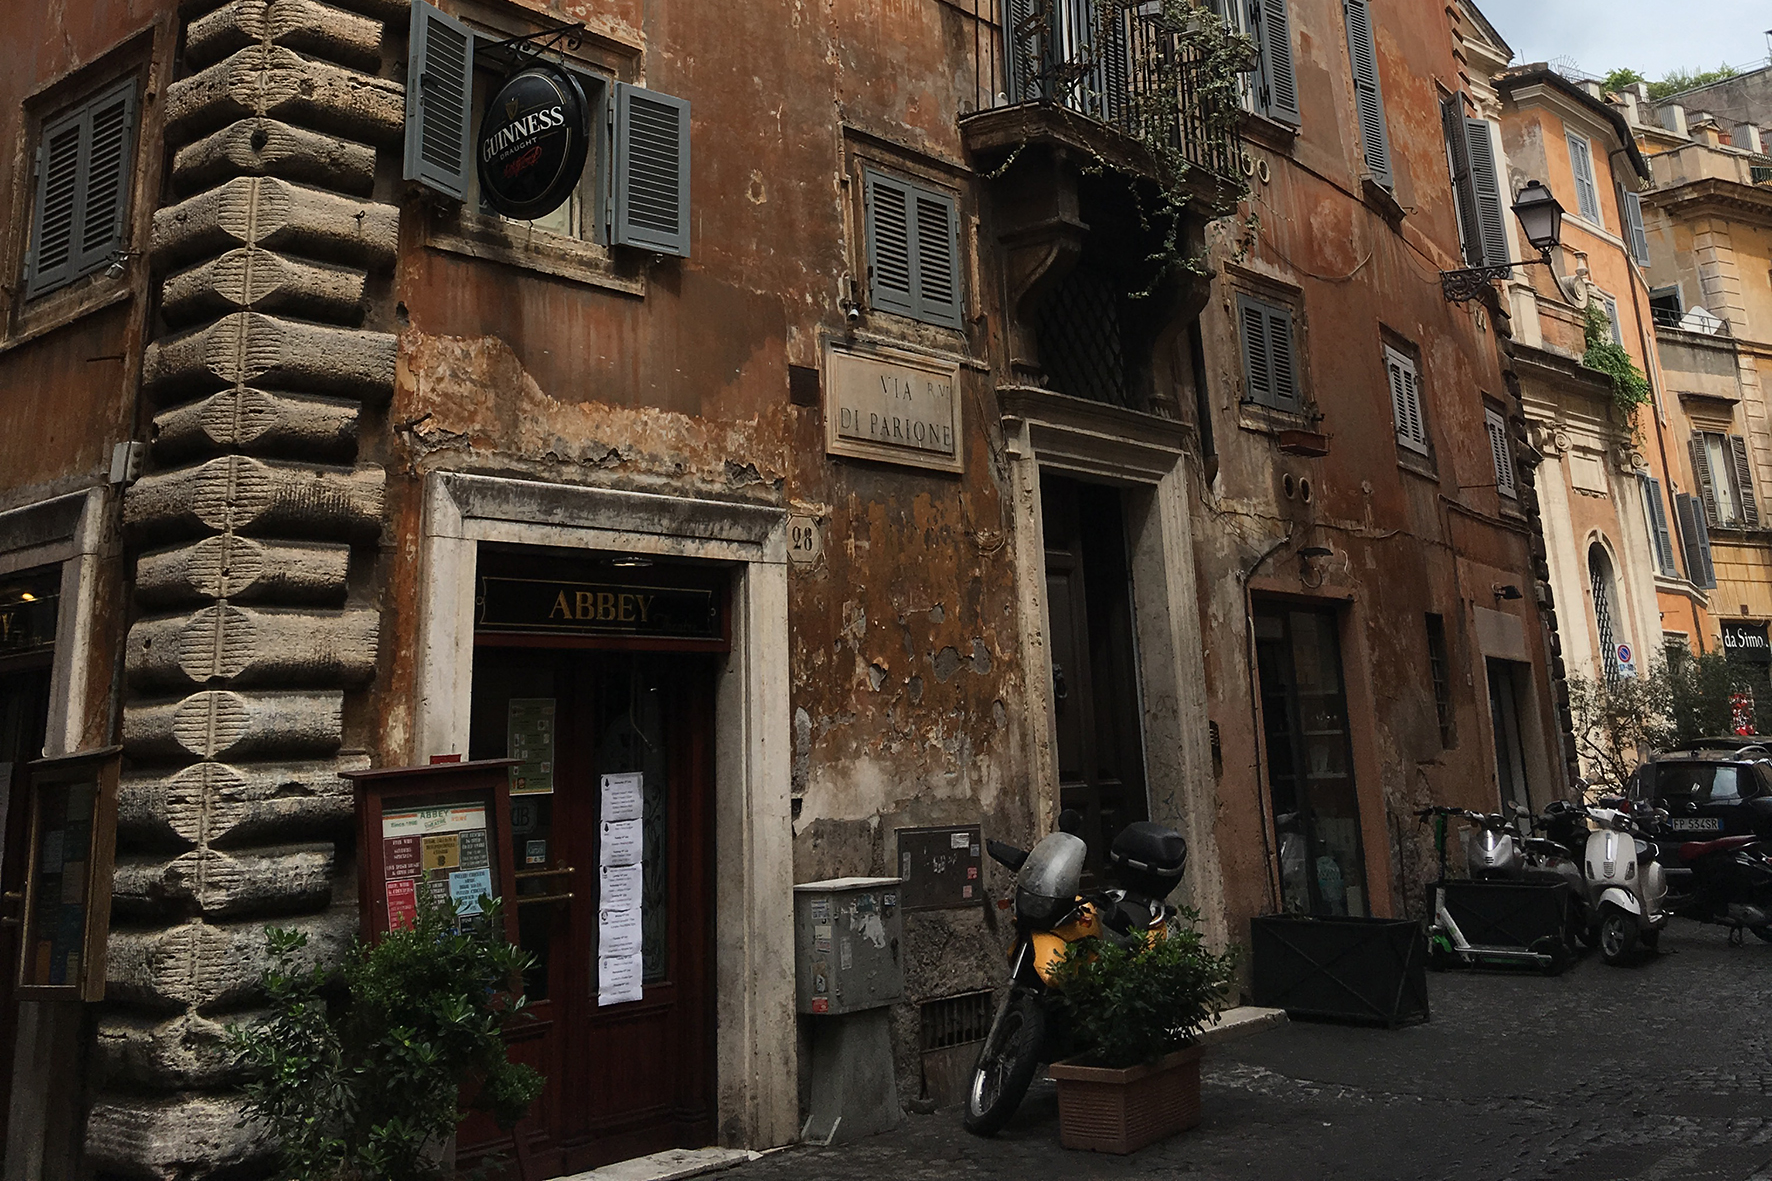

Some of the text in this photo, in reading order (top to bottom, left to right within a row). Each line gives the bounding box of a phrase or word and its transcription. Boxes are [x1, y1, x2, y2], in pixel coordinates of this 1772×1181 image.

[483, 106, 565, 162] GUINNESS
[500, 137, 538, 160] DRAUGHT
[881, 375, 912, 401] VIA
[841, 408, 951, 446] DI PARIONE
[792, 525, 812, 551] 28
[549, 589, 654, 622] ABBEY
[1725, 629, 1736, 648] da
[420, 810, 449, 820] ABBEY
